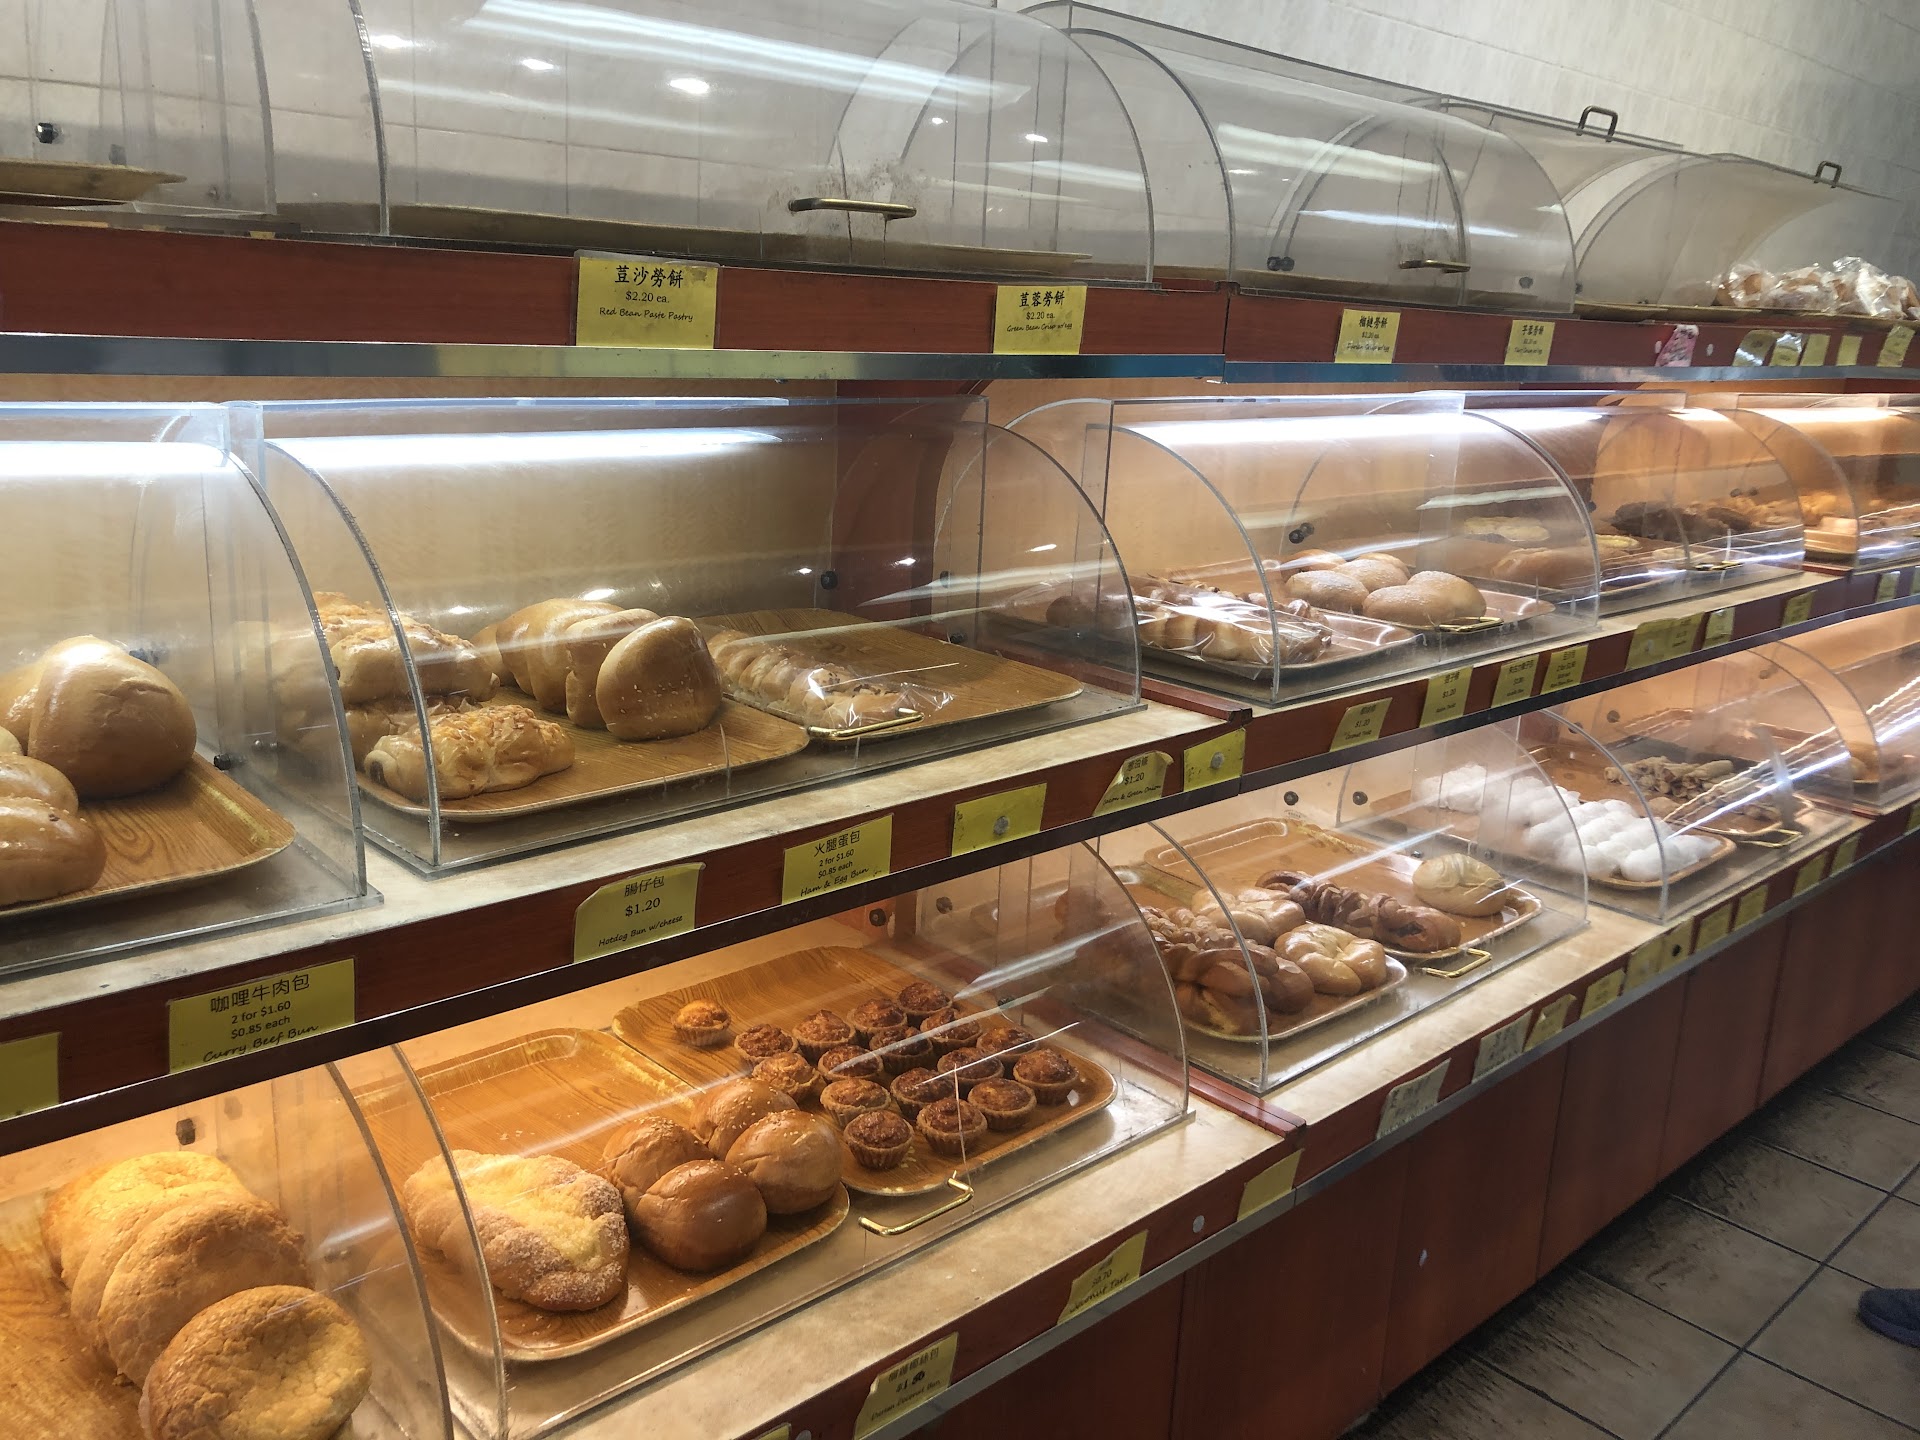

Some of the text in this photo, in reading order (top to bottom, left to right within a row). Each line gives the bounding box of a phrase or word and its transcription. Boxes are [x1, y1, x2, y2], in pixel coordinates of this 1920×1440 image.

[625, 291, 670, 303] $2.20 ea.
[600, 307, 693, 322] Red Bean Paste Pastry
[1026, 311, 1044, 320] $2.20
[1124, 772, 1144, 785] $1.20
[1127, 790, 1143, 798] Green
[1144, 785, 1161, 793] Onion
[814, 830, 860, 857] 火腿蛋包
[825, 857, 835, 865] for
[836, 849, 854, 862] $1.60
[818, 861, 853, 879] $0.85 each
[624, 876, 665, 897] 腸仔包
[800, 868, 869, 897] Ham & Egg Bun
[625, 898, 661, 917] $1.20
[598, 915, 683, 947] Hotdog Bun w/cheese
[210, 974, 310, 1013] 咖哩牛肉包
[231, 1000, 291, 1024] 2 for $1.60
[231, 1015, 291, 1040] $0.85 each
[203, 1024, 319, 1063] Curry Beef Bun
[1110, 1272, 1130, 1288] Tart
